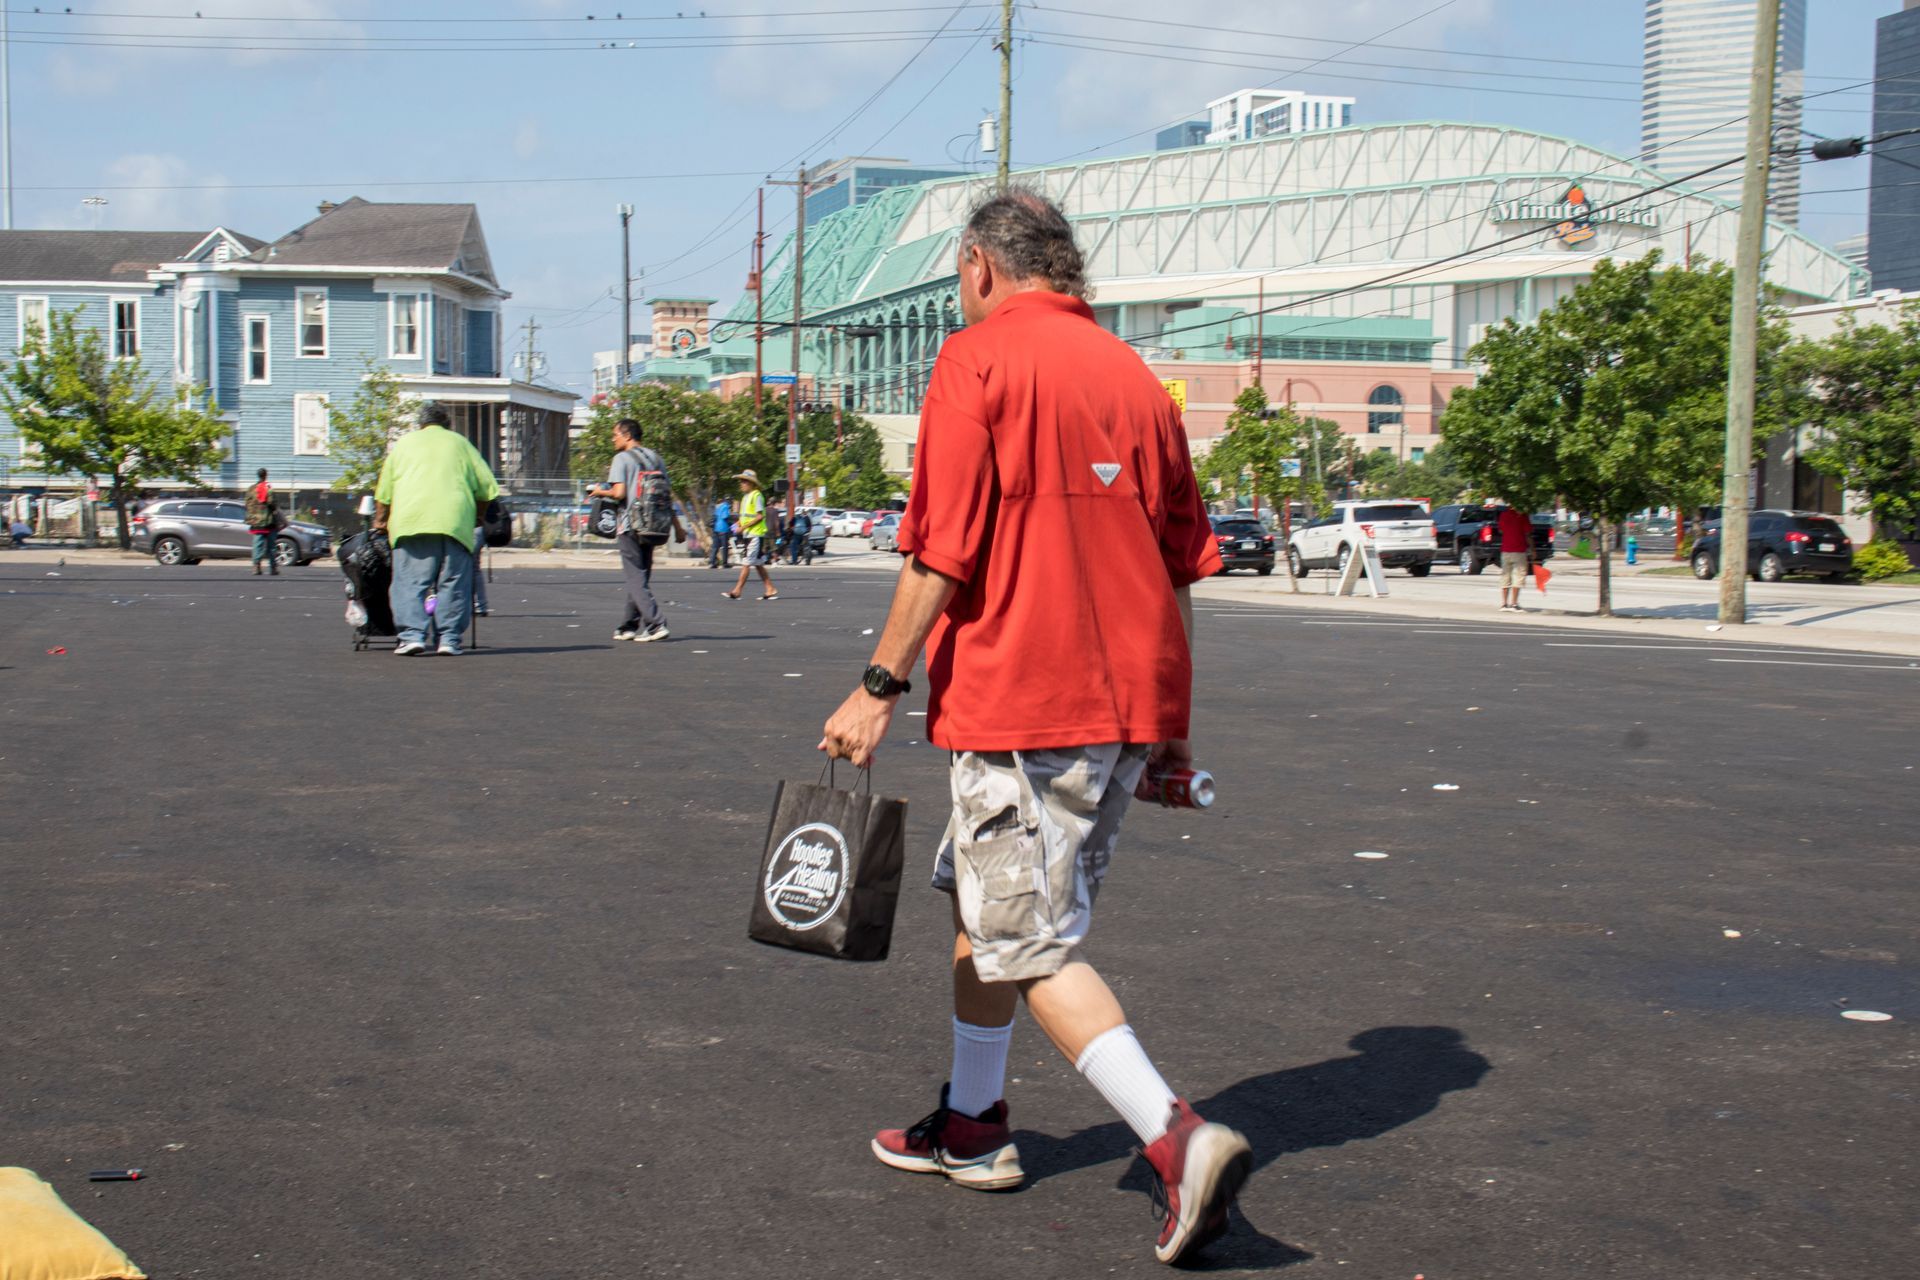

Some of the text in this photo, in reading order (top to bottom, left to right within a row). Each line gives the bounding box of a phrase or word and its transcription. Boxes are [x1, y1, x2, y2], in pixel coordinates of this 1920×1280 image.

[1492, 200, 1661, 226] Minute Maid
[789, 838, 834, 870] Hoodies
[793, 861, 839, 898] Healing
